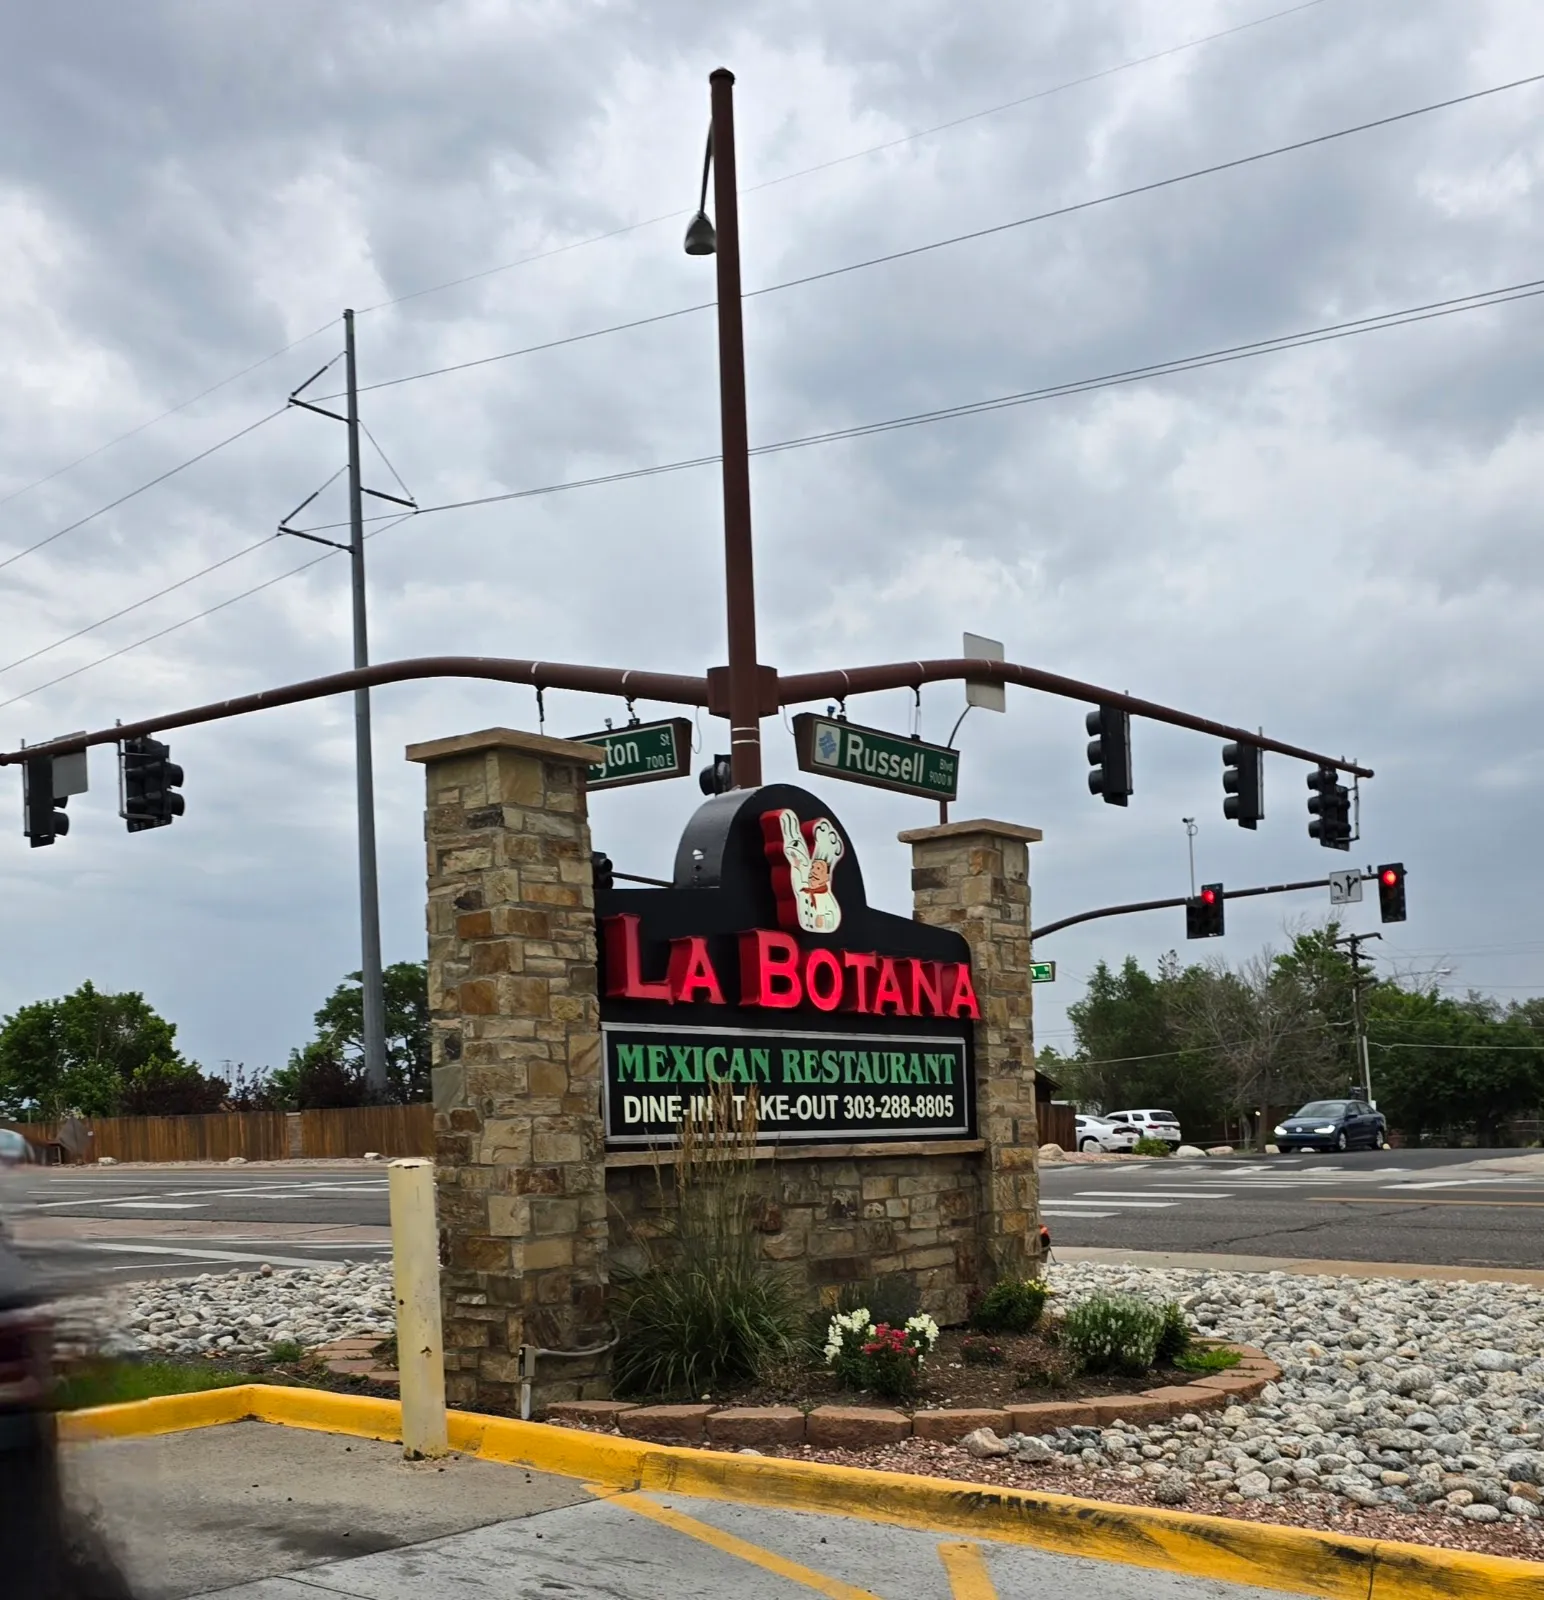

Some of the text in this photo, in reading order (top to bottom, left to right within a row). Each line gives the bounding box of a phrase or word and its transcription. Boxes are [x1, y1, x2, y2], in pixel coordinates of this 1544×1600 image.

[659, 732, 671, 747] St
[645, 753, 674, 769] 700 E
[845, 733, 925, 783] Russell
[608, 913, 982, 1020] LA BOTANA
[616, 1043, 957, 1085] MEXICAN RESTAURANT
[623, 1095, 714, 1123] DINE-IN
[843, 1094, 954, 1119] 303-288-8805
